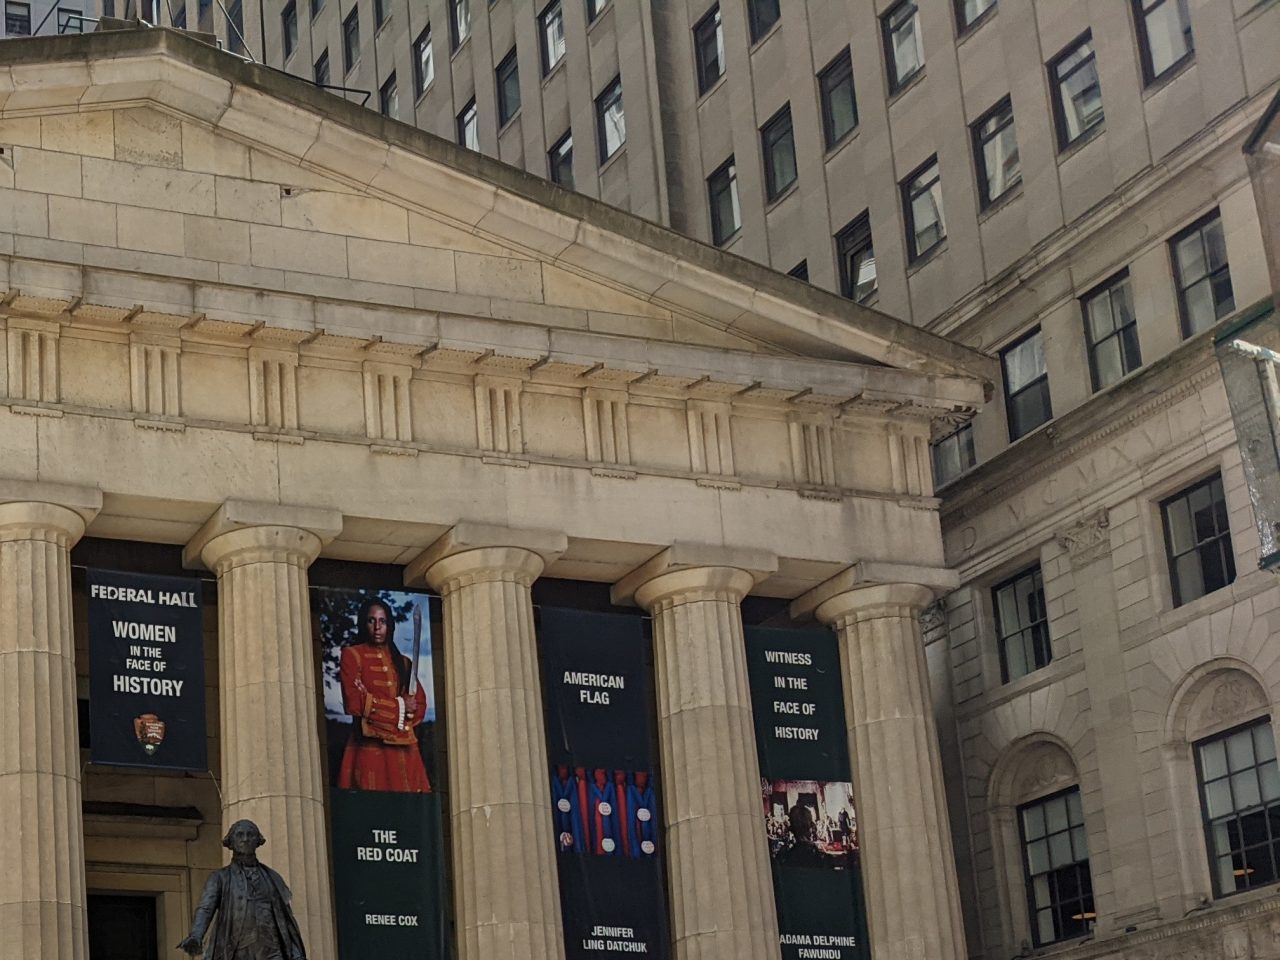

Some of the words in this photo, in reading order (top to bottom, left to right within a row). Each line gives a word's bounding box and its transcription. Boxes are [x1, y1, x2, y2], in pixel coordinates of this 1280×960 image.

[92, 585, 155, 603] FEDERAL
[159, 592, 197, 607] HALL
[113, 621, 175, 642] WOMEN
[131, 646, 140, 656] IN
[143, 647, 161, 658] THE
[765, 651, 811, 665] WITNESS
[127, 659, 150, 670] FACE
[154, 661, 166, 671] OF
[114, 675, 183, 696] HISTORY
[564, 672, 624, 688] AMERICAN
[775, 677, 785, 688] IN
[787, 678, 807, 689] THE
[580, 690, 609, 704] FLAG
[774, 702, 800, 714] FACE
[802, 704, 815, 715] OF
[775, 727, 818, 740] HISTORY
[372, 830, 397, 843] THE
[358, 847, 382, 860] RED
[386, 849, 418, 862] COAT
[366, 914, 396, 925] RENEE
[399, 916, 418, 926] COX
[592, 926, 633, 938] JENNIFER
[583, 940, 604, 950] LING
[607, 941, 647, 952] DATCHUK
[780, 934, 811, 945] ADAMA
[813, 936, 855, 946] DELPHINE
[799, 949, 840, 959] FAWUNDU
